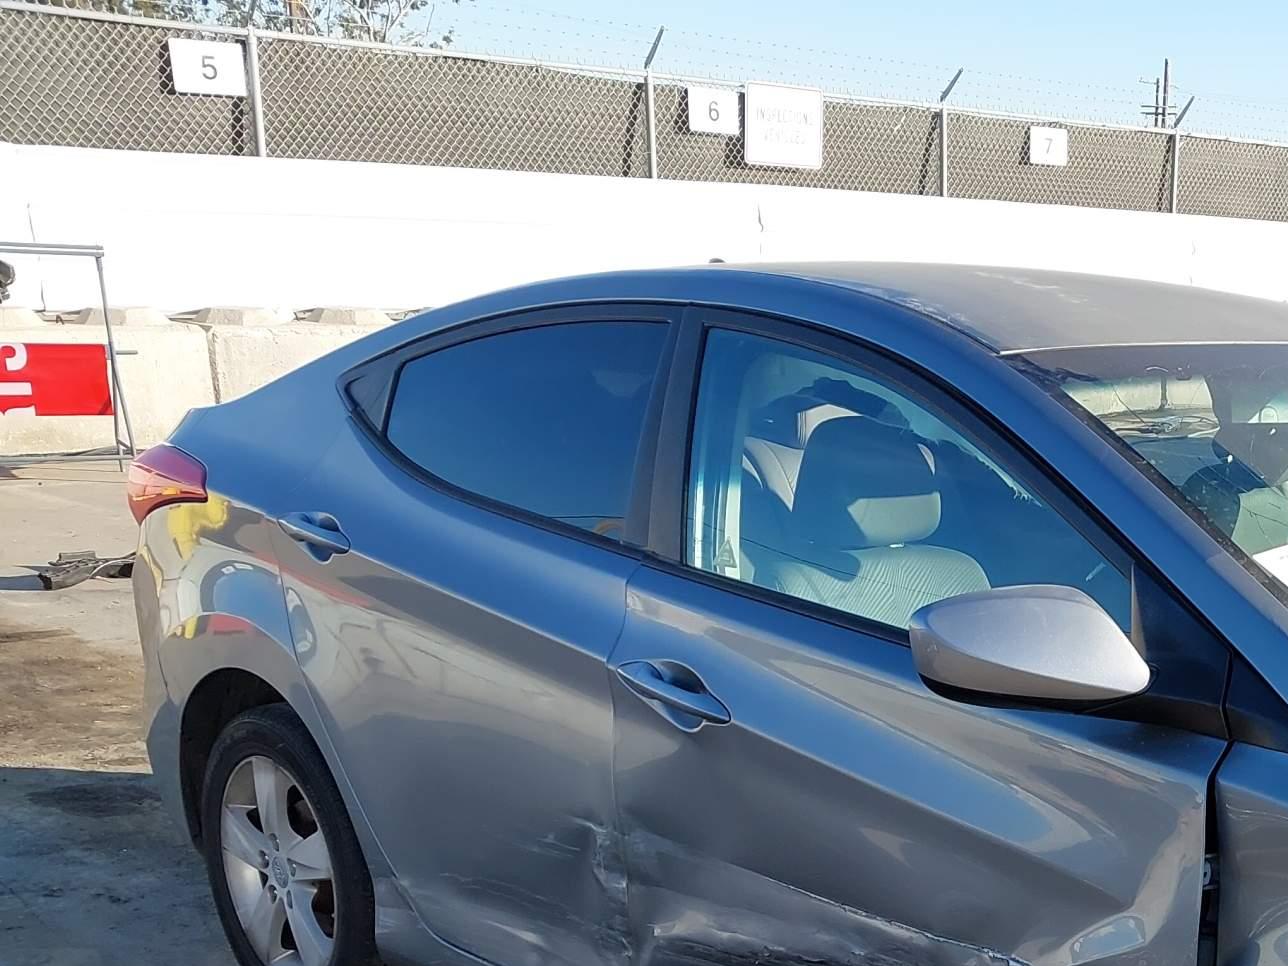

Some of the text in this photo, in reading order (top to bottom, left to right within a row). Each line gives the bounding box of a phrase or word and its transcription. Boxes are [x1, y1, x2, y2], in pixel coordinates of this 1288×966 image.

[201, 55, 218, 80] 5
[708, 100, 720, 121] 6
[1044, 138, 1054, 154] 7
